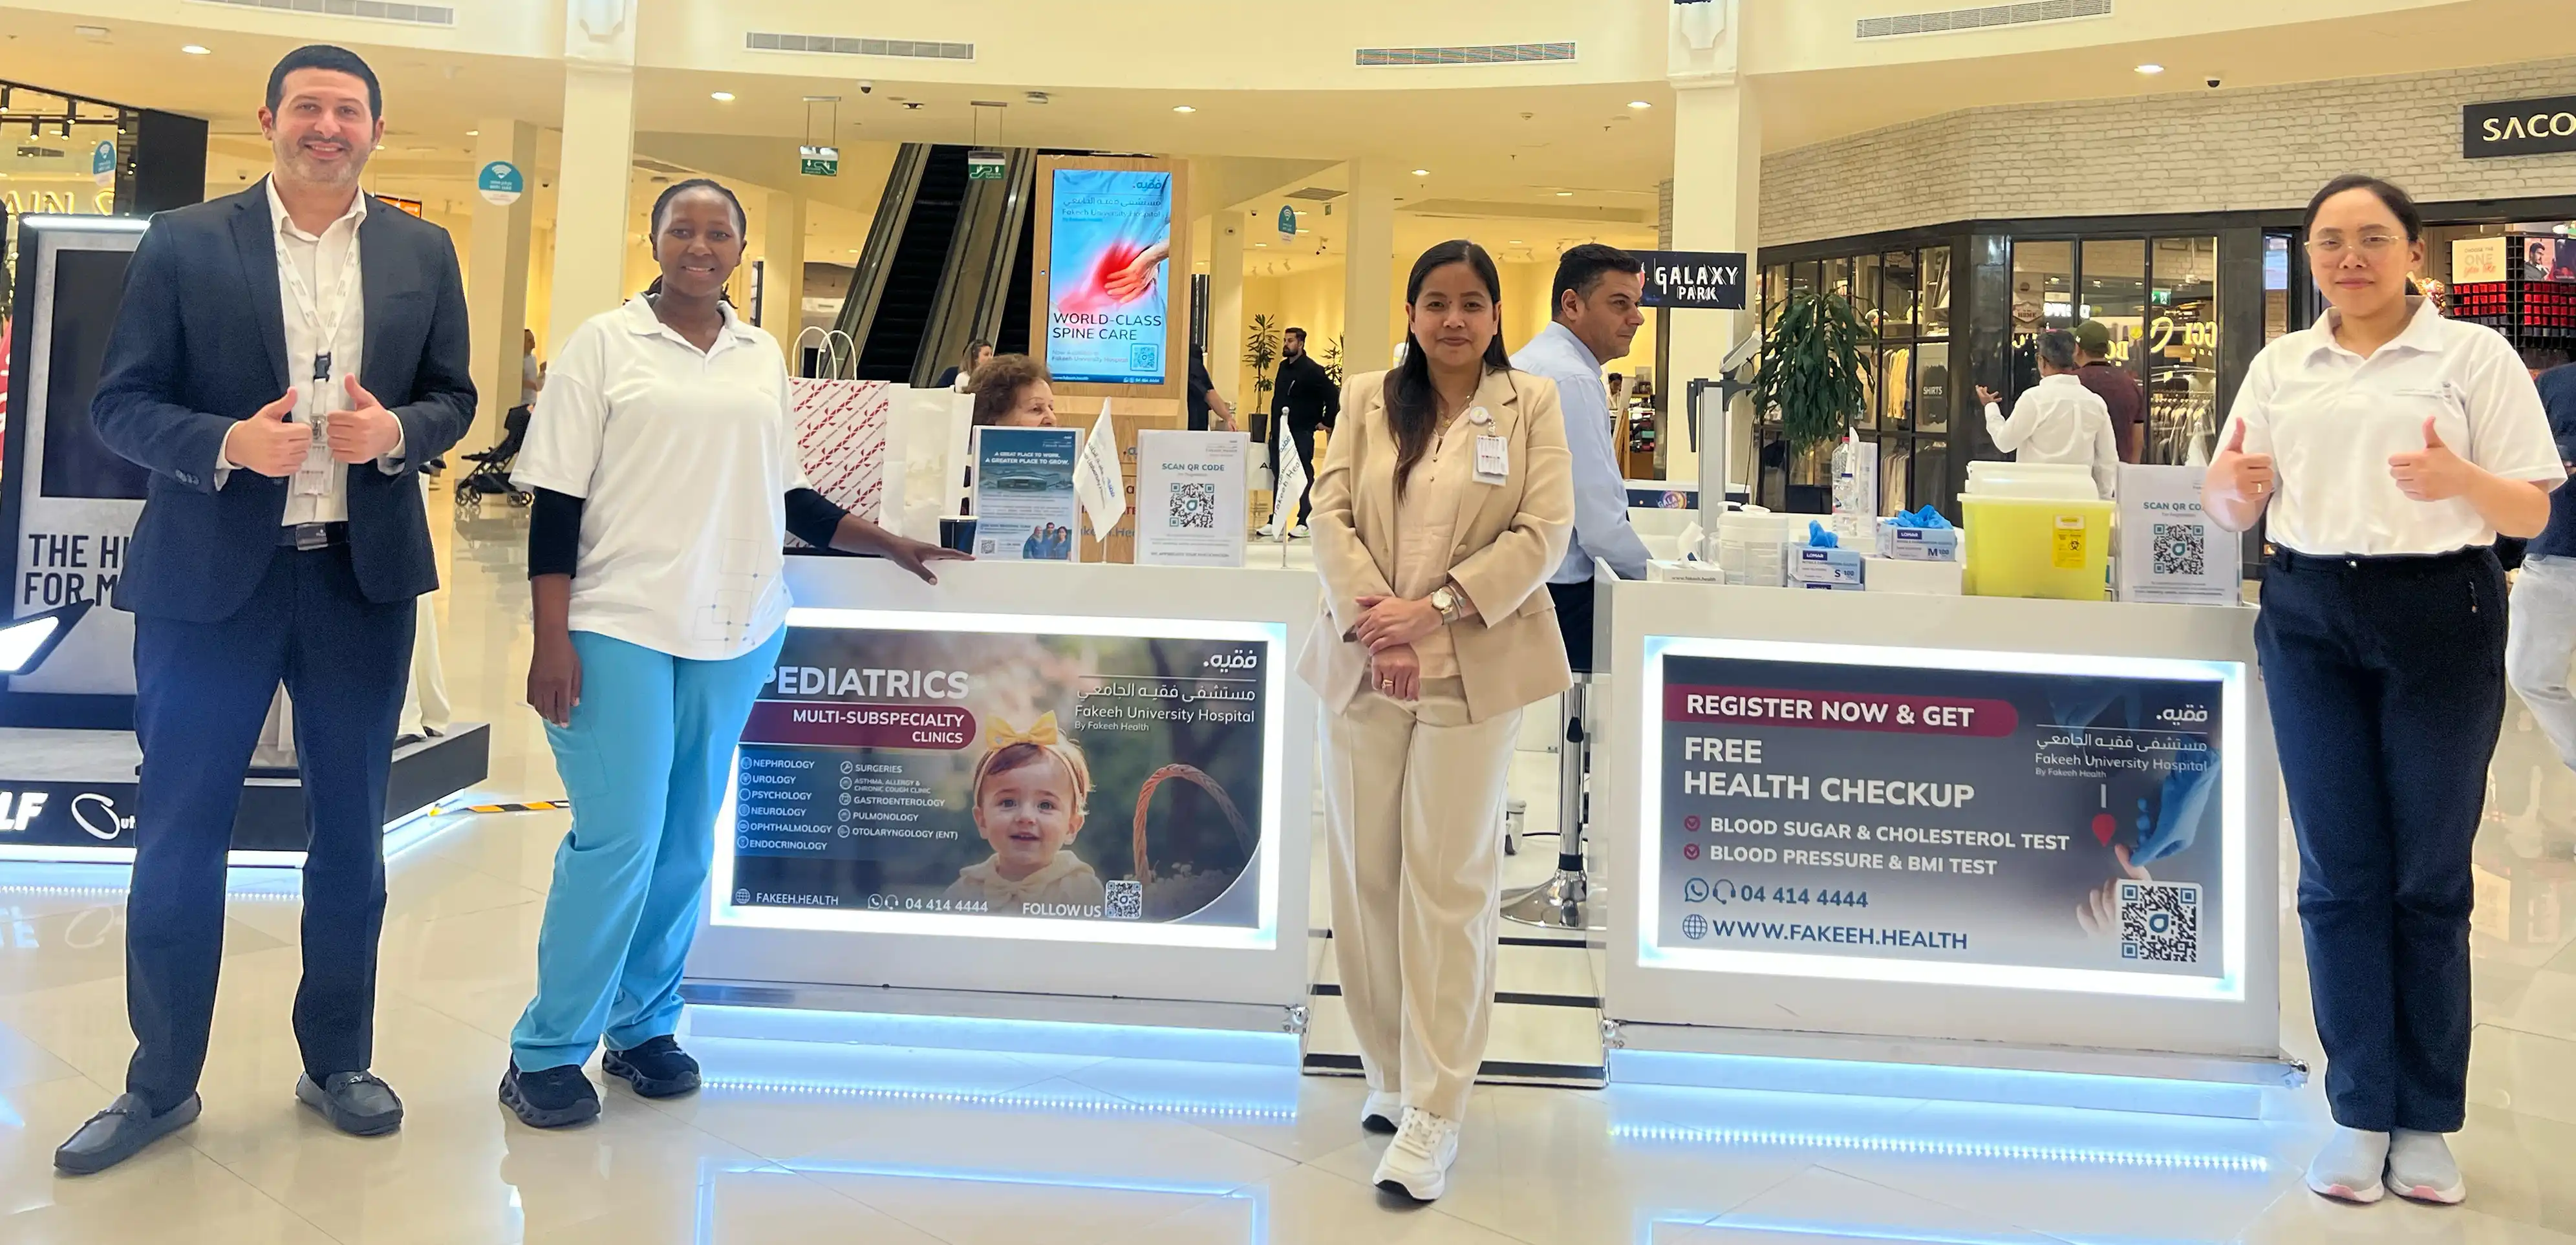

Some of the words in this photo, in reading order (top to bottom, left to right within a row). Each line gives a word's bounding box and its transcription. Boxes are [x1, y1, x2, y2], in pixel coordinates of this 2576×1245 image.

[2482, 112, 2576, 142] SACO
[2464, 253, 2494, 266] ONE
[1655, 264, 1738, 295] GALAXY
[1677, 286, 1717, 301] PARK
[1053, 313, 1162, 326] WORLD-CLASS
[1053, 327, 1095, 339] SPINE
[1099, 328, 1137, 340] CARE
[1923, 386, 1942, 395] SHIRTS
[28, 534, 89, 567] THE
[24, 572, 85, 606] FOR
[1077, 682, 1135, 701] الجامعي
[1138, 683, 1179, 701] فقيه
[1182, 685, 1256, 703] مستشفى
[793, 708, 965, 727] MULTI-SUBSPECIALTY
[1075, 704, 1123, 718] Fakeeh
[1127, 706, 1195, 723] University
[1198, 708, 1255, 725] Hospital
[1687, 694, 1813, 720] REGISTER
[1821, 700, 1888, 723] NOW
[1896, 704, 1915, 725] &
[1922, 705, 1975, 727] GET
[1074, 721, 1086, 732] By
[1088, 721, 1119, 731] Fakeeh
[1121, 722, 1150, 732] Health
[912, 730, 963, 744] CLINICS
[2036, 732, 2092, 750] الجامعي
[2095, 734, 2134, 750] فقيه
[1684, 736, 1763, 764] FREE
[753, 759, 815, 770] NEPHROLOGY
[855, 764, 903, 774] SURGERIES
[2035, 752, 2082, 765] Fakeeh
[2085, 754, 2149, 771] University
[2152, 758, 2207, 774] Hospital
[752, 775, 797, 785] UROLOGY
[2035, 767, 2046, 777] By
[2048, 767, 2077, 777] Fakeeh
[2079, 768, 2107, 778] Health
[751, 791, 812, 801] PSYCHOLOGY
[1684, 771, 1809, 800] HEALTH
[1820, 776, 1975, 808] CHECKUP
[853, 796, 945, 807] GASTROENTEROLOGY
[751, 807, 806, 817] NEUROLOGY
[852, 812, 919, 822] PULMONOLOGY
[750, 822, 832, 835] OPHTHALMOLOGY
[852, 827, 934, 839] OTOLARYNGOLOGY
[935, 829, 958, 840] (ENT)
[1710, 817, 1777, 836] BLOOD
[1783, 820, 1851, 839] SUGAR
[1858, 824, 1871, 840] &
[1876, 825, 2015, 847] CHOLESTEROL
[2021, 833, 2070, 851] TEST
[749, 839, 828, 851] ENDOCRINOLOGY
[1710, 846, 1777, 864] BLOOD
[1783, 849, 1884, 869] PRESSURE
[1888, 854, 1902, 871] &
[1908, 855, 1944, 872] BMI
[1949, 857, 1997, 875] TEST
[756, 892, 839, 906] FAKEEH.HEALTH
[1741, 884, 1766, 902] 04
[1772, 886, 1810, 905] 414
[1816, 889, 1868, 908] 4444
[905, 897, 923, 910] 04
[925, 898, 951, 911] 414
[954, 899, 989, 913] 4444
[1022, 902, 1081, 917] FOLLOW
[1083, 904, 1102, 917] US
[1713, 919, 1968, 950] WWW.FAKEEH.HEALTH
